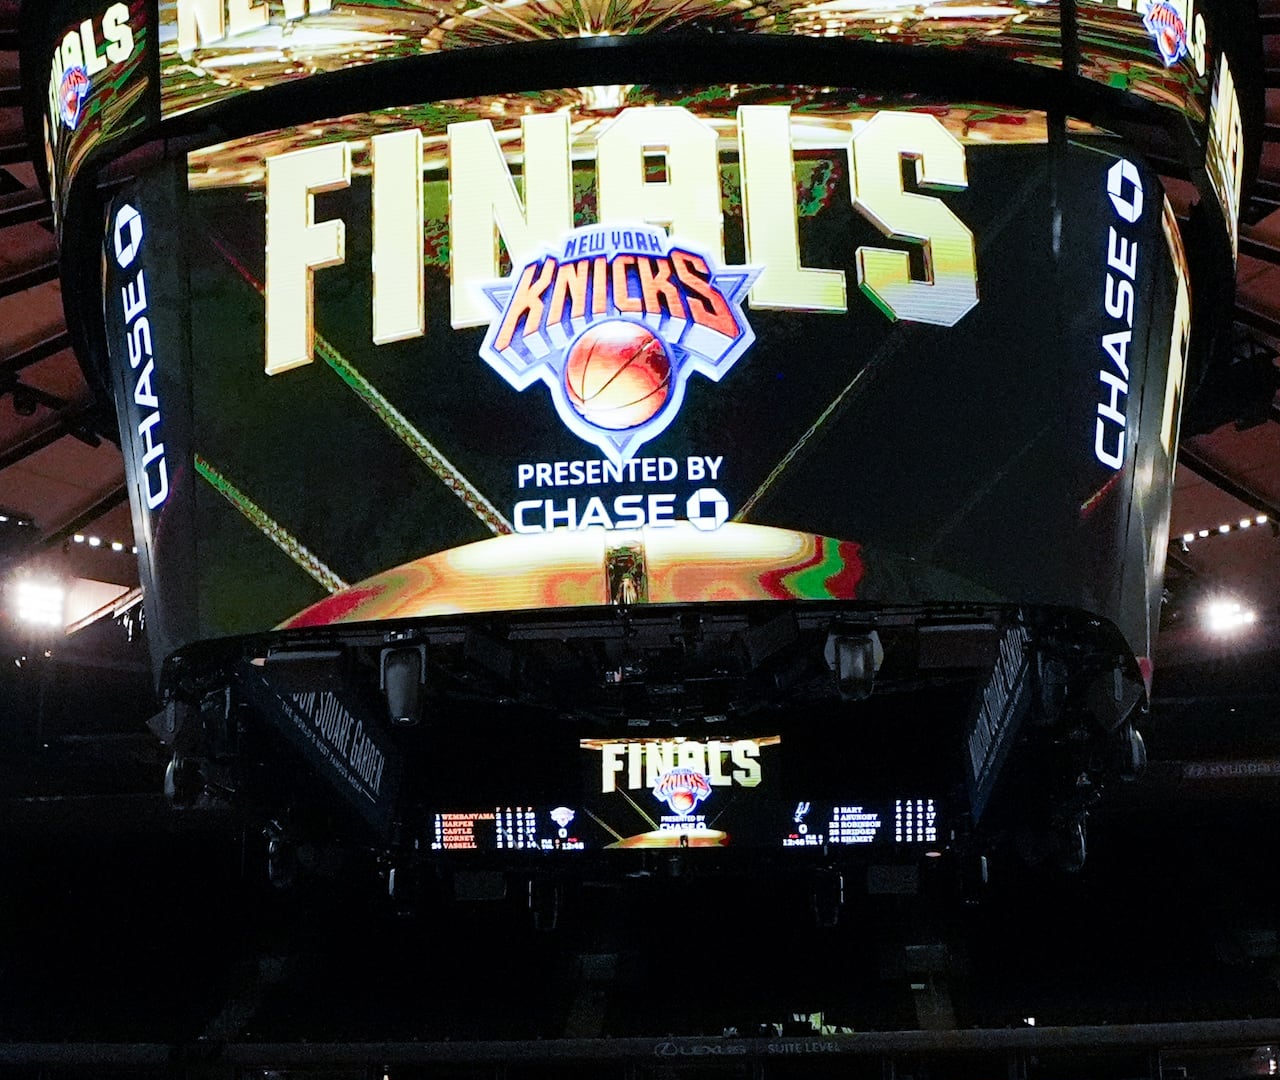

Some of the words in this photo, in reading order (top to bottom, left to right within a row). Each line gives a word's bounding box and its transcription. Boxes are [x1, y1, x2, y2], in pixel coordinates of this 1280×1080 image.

[264, 104, 979, 377] FINALS
[564, 236, 605, 258] NEW
[611, 231, 662, 252] YORK
[493, 248, 740, 352] KNICKS
[1094, 224, 1137, 471] CHASE
[120, 280, 170, 512] CHASE
[517, 458, 679, 488] PRESENTED
[687, 456, 723, 480] BY
[513, 493, 678, 534] CHASE
[350, 719, 385, 796] GARDEN
[602, 739, 762, 793] FINALS
[659, 773, 708, 790] KNICKS
[558, 828, 567, 838] 0
[659, 823, 697, 831] CHASE
[798, 824, 808, 834] 0
[767, 1042, 802, 1054] SUITE
